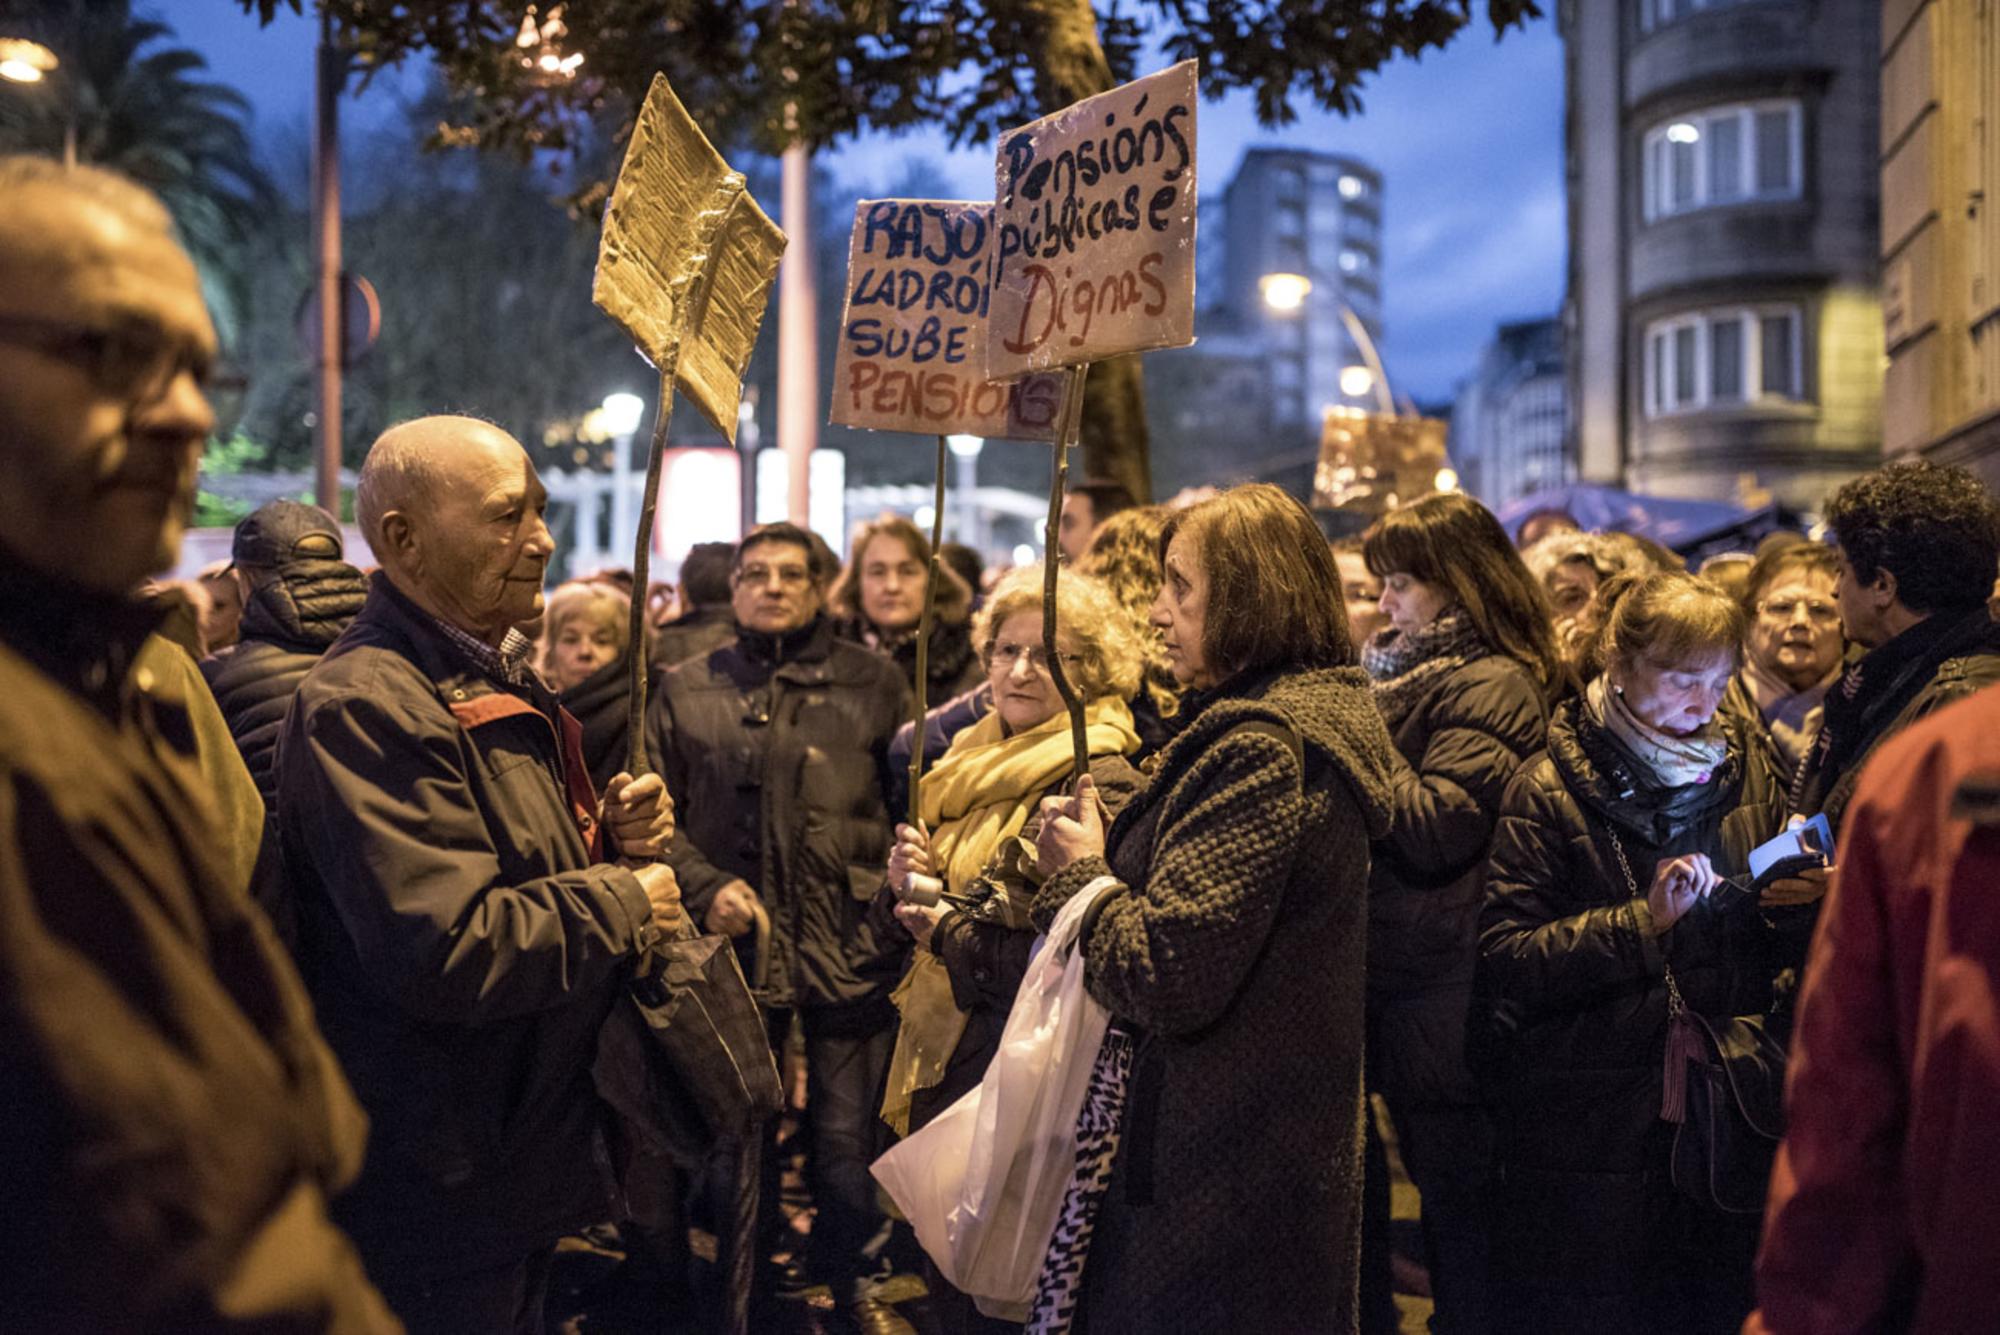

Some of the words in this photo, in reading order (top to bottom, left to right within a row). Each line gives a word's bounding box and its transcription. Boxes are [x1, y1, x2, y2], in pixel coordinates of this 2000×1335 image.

[863, 201, 994, 279] RAJO
[995, 184, 1140, 290] públicas
[1148, 185, 1178, 231] e
[847, 315, 968, 363] SUBE
